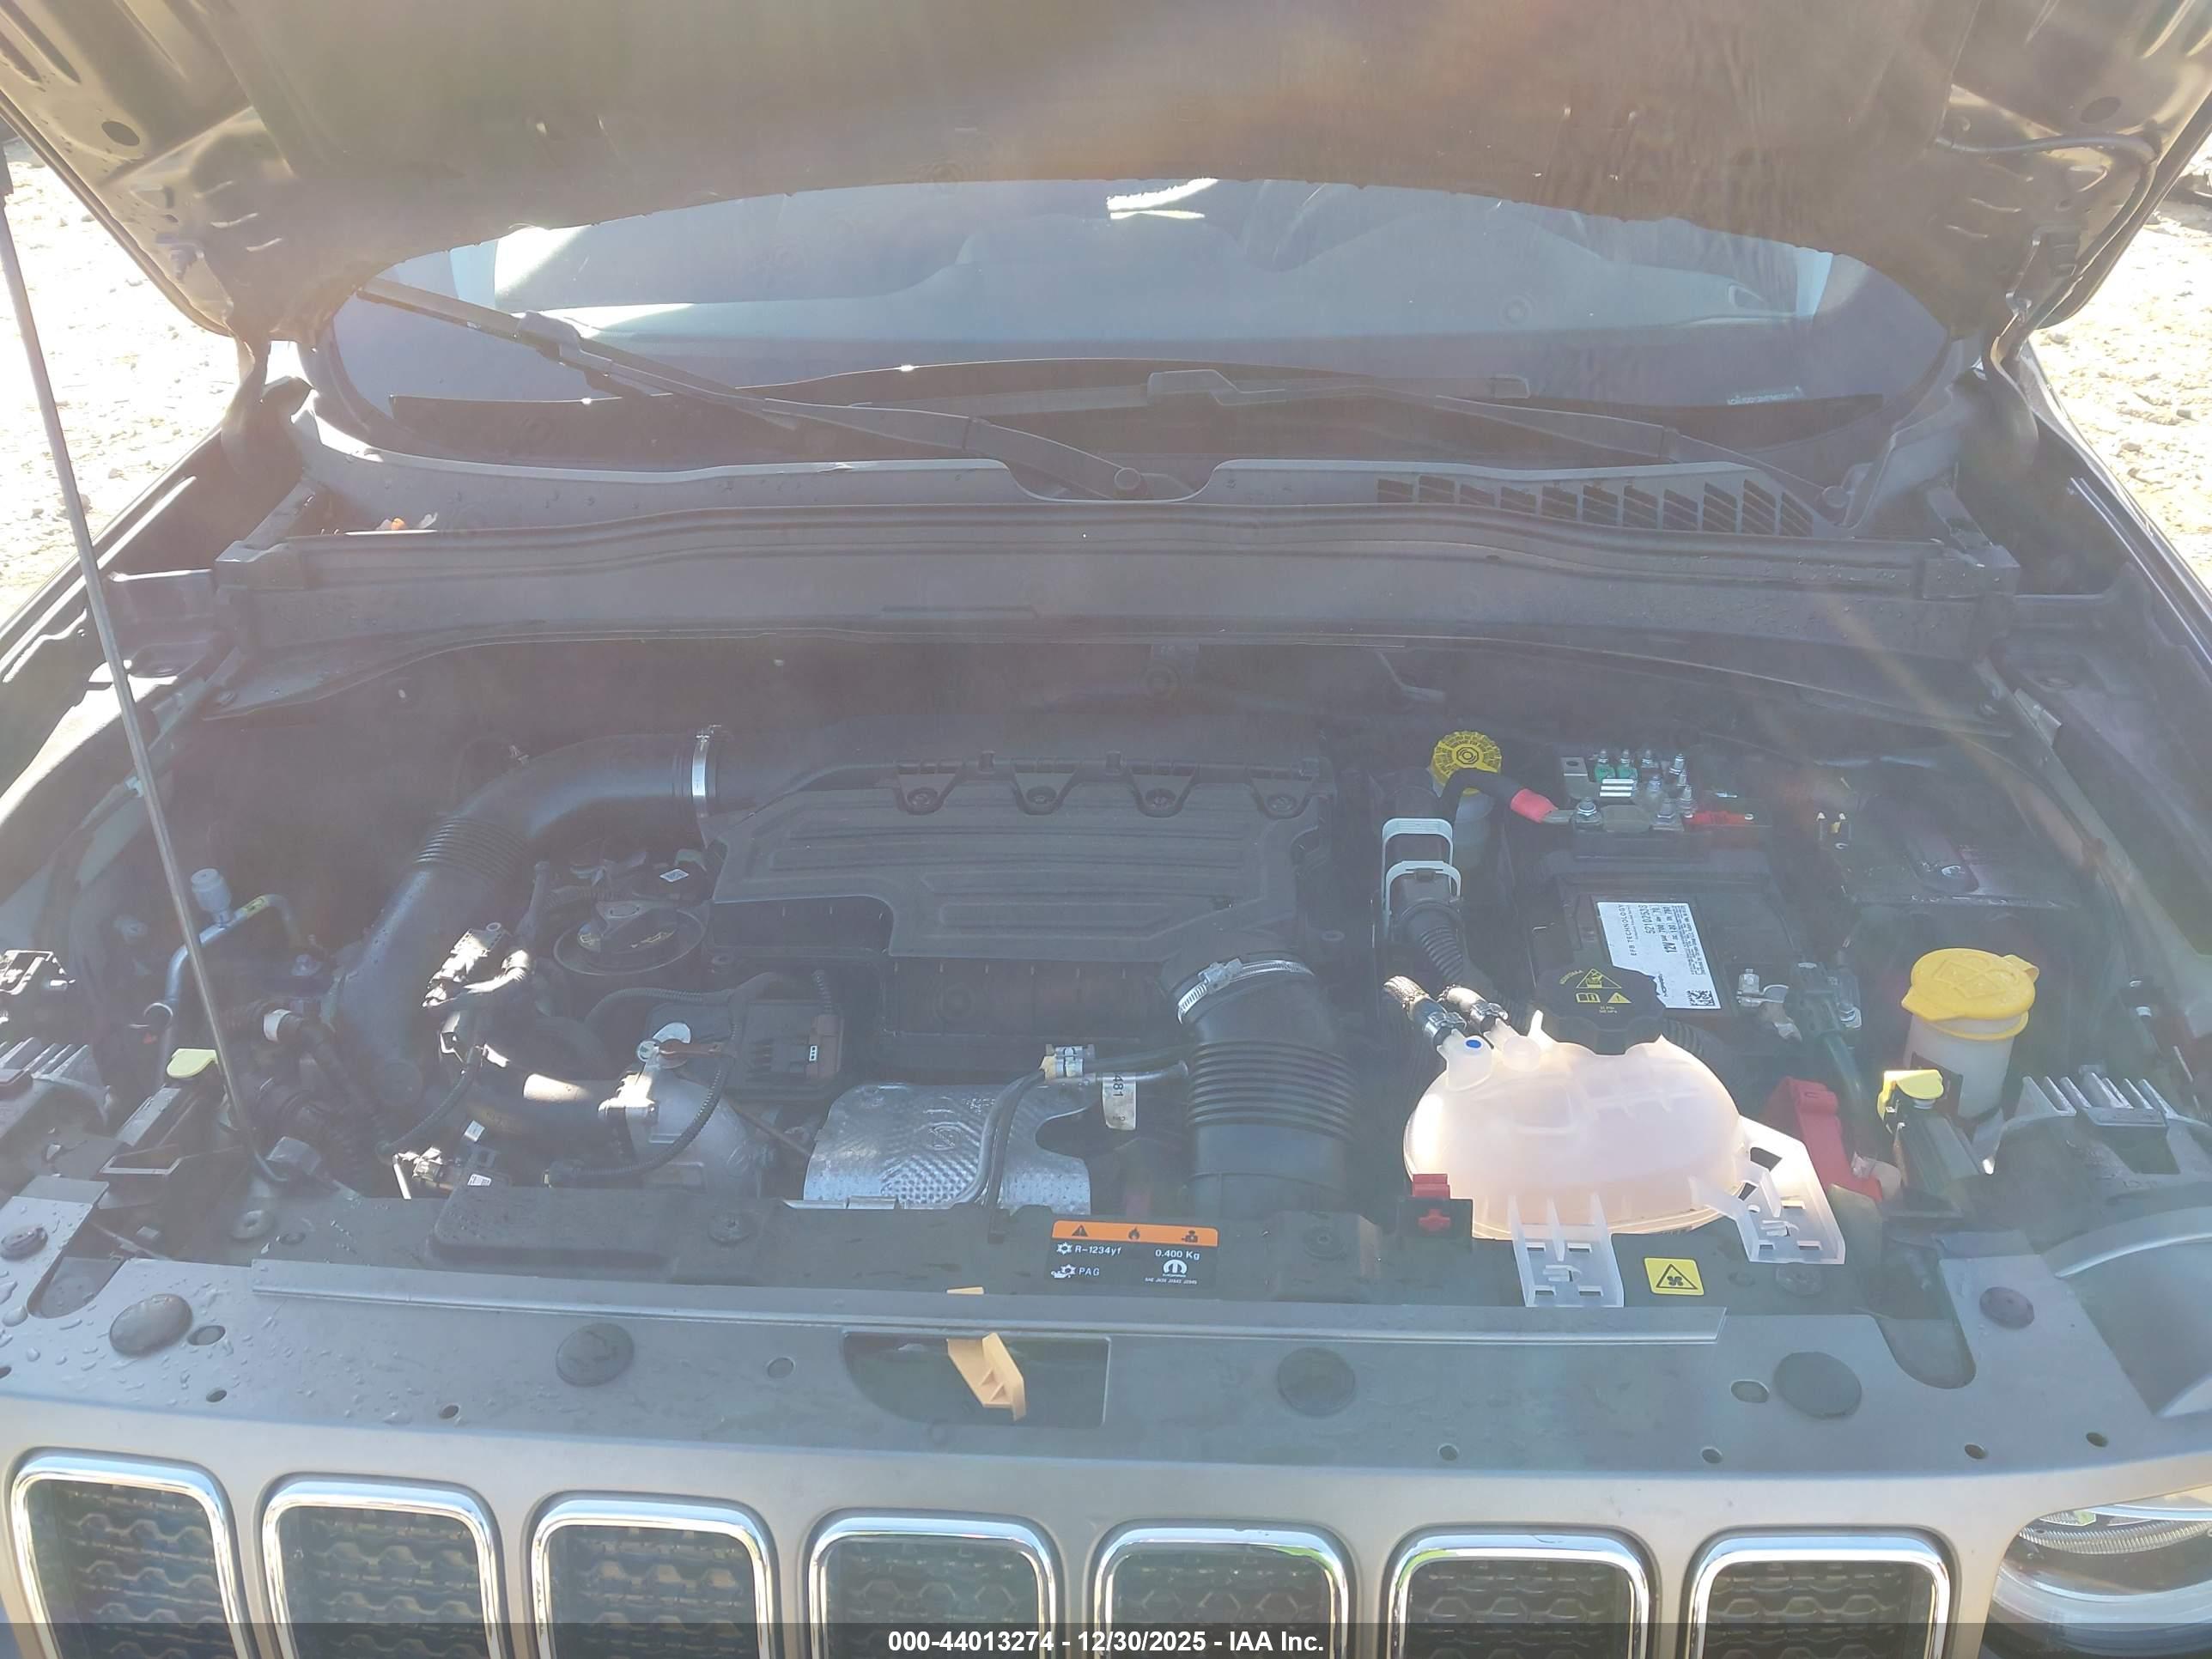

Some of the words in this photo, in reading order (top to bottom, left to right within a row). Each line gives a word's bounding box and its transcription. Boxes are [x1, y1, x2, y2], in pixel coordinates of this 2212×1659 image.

[1618, 904, 1635, 943] TECHNOLOGY
[1662, 942, 1678, 953] 12V
[1074, 1245, 1121, 1256] R-1234yf
[1155, 1249, 1183, 1258] 0.400
[1186, 1250, 1200, 1261] Kg
[1079, 1267, 1100, 1276] PAG
